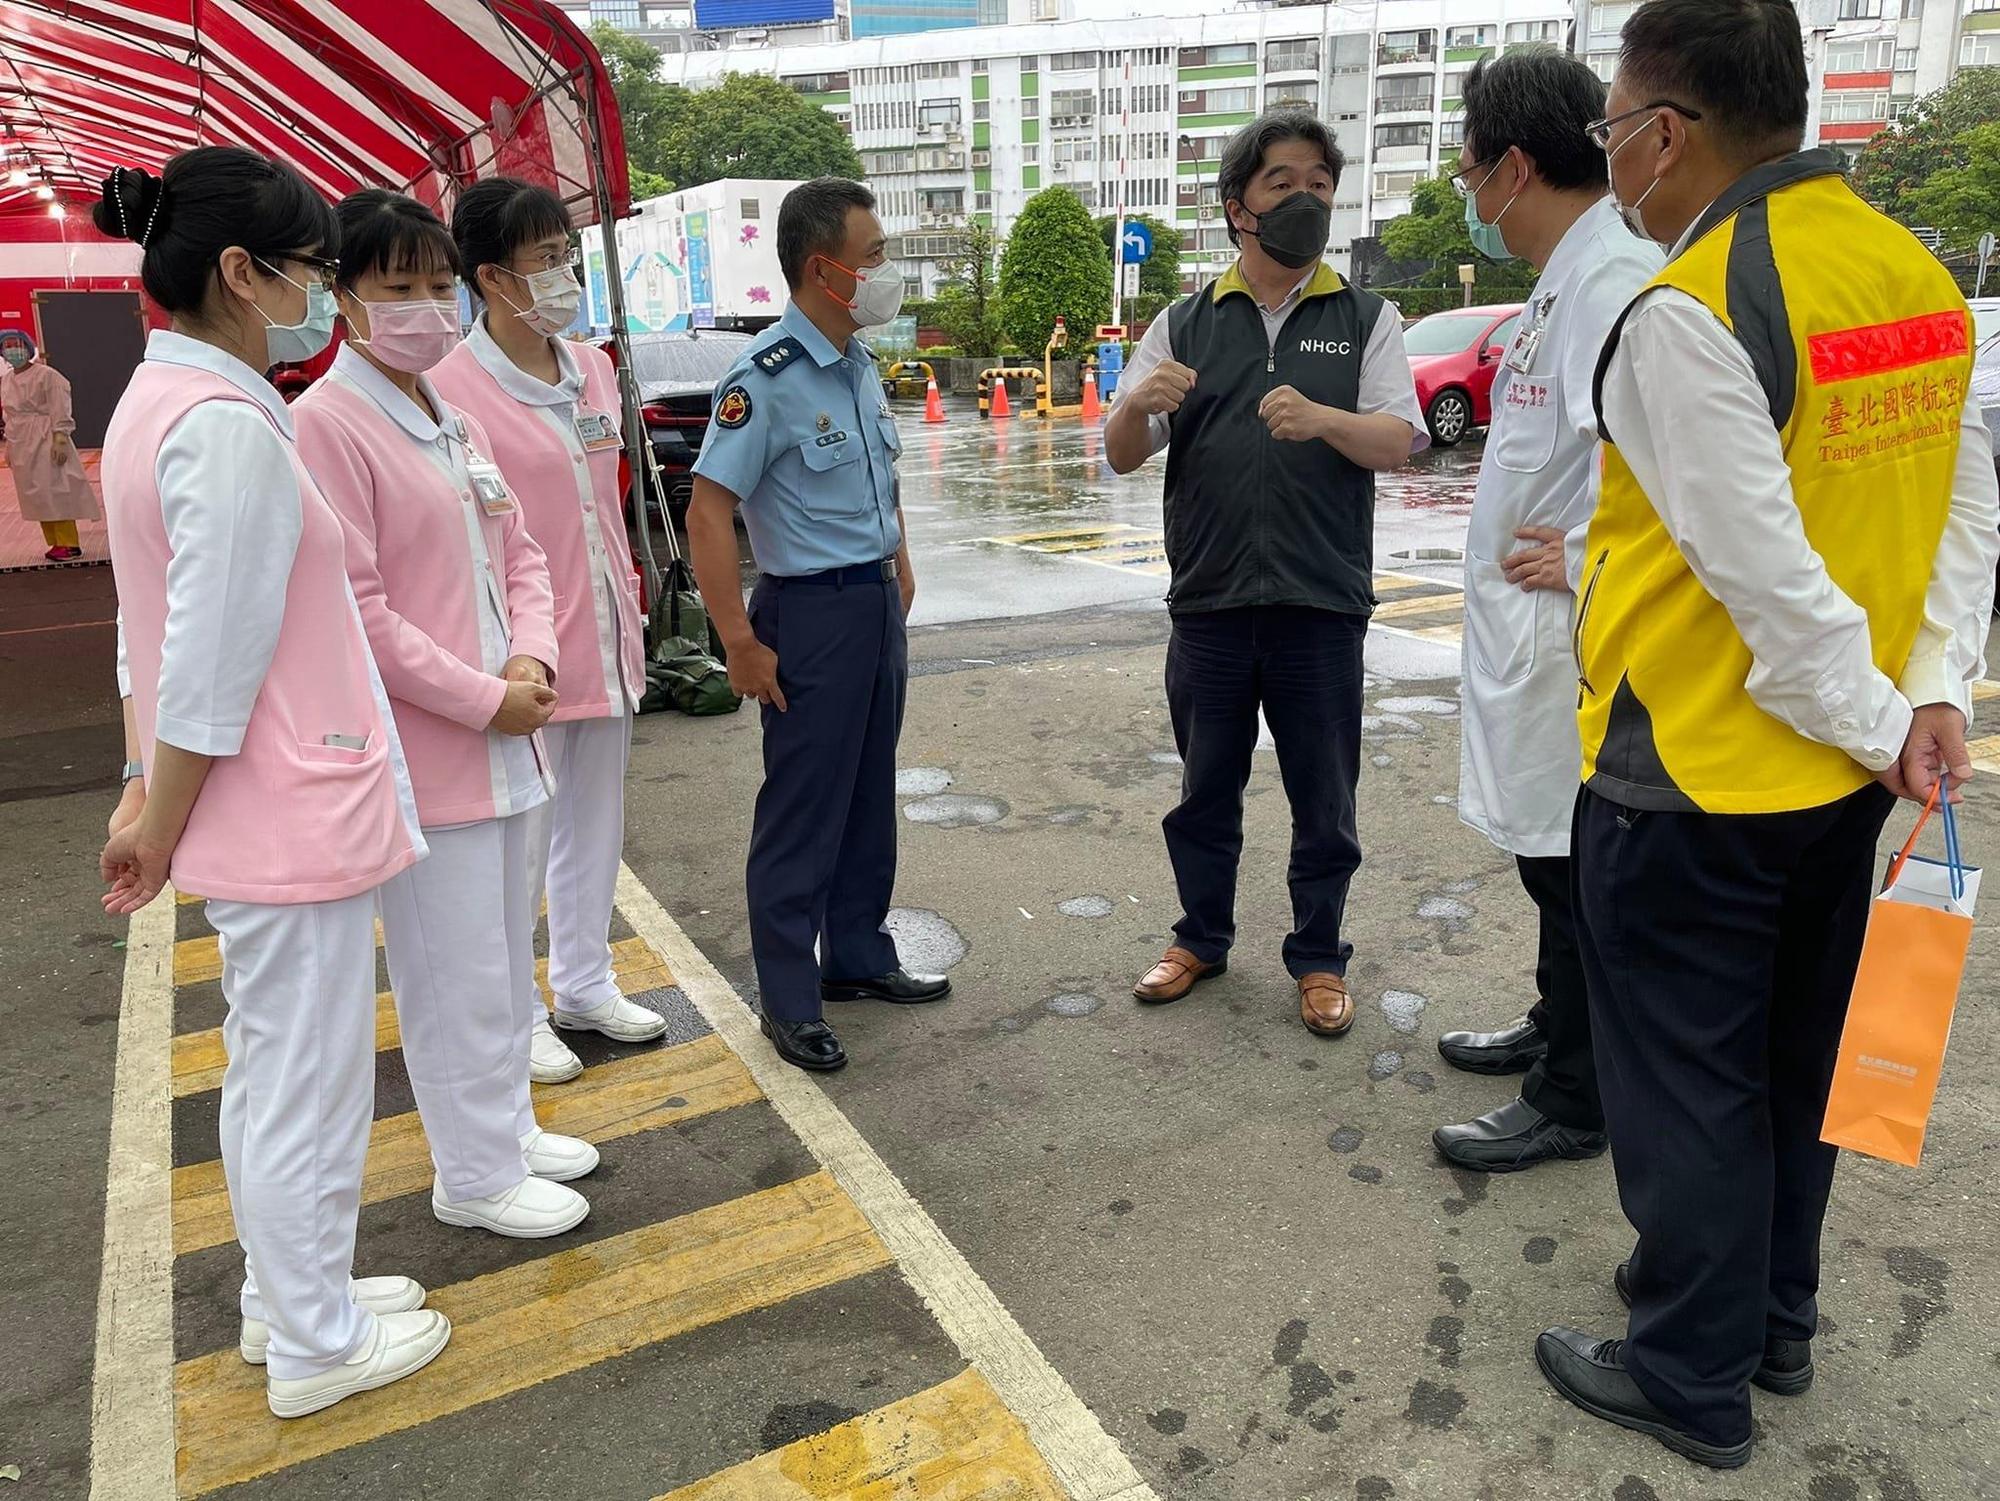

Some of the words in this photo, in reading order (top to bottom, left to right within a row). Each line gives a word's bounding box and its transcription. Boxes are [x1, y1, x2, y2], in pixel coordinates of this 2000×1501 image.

[1300, 339, 1350, 355] NHCC
[1818, 440, 1871, 462] Taipei
[1875, 419, 1945, 452] International
